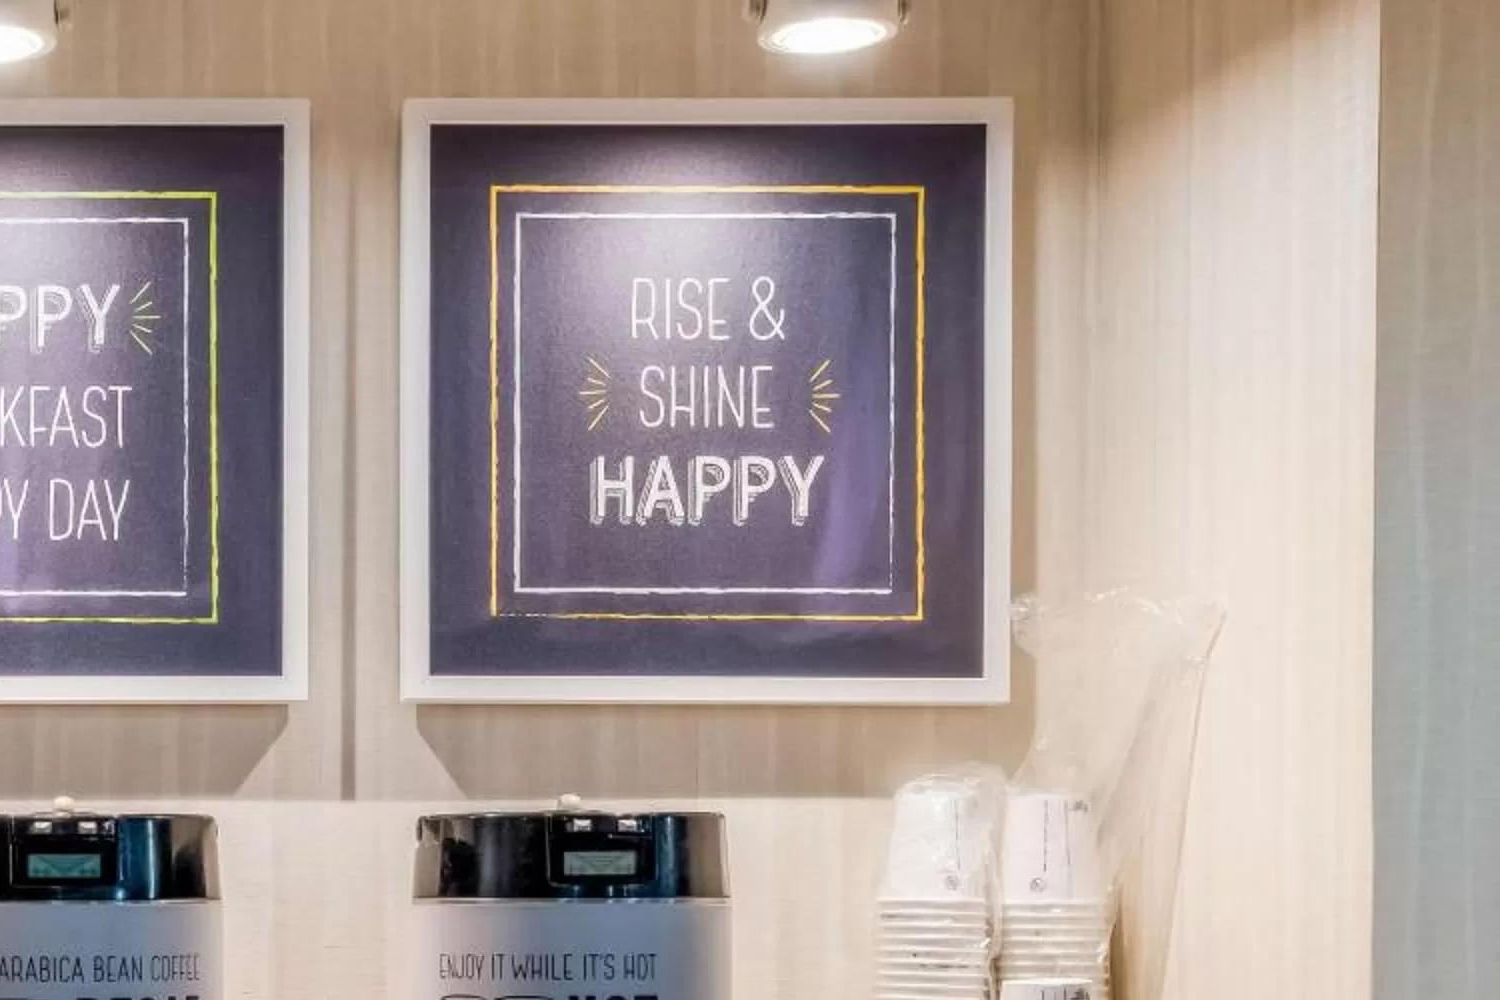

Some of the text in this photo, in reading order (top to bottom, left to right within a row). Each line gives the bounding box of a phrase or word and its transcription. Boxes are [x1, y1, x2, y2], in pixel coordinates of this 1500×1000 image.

[631, 275, 786, 341] RISE &
[639, 365, 775, 429] SHINE
[49, 480, 131, 541] DAY
[590, 455, 825, 526] HAPPY
[93, 955, 143, 983] BEAN
[151, 953, 201, 982] COFFEE
[439, 953, 658, 981] ENJOY IT WHILE IT'S HOT
